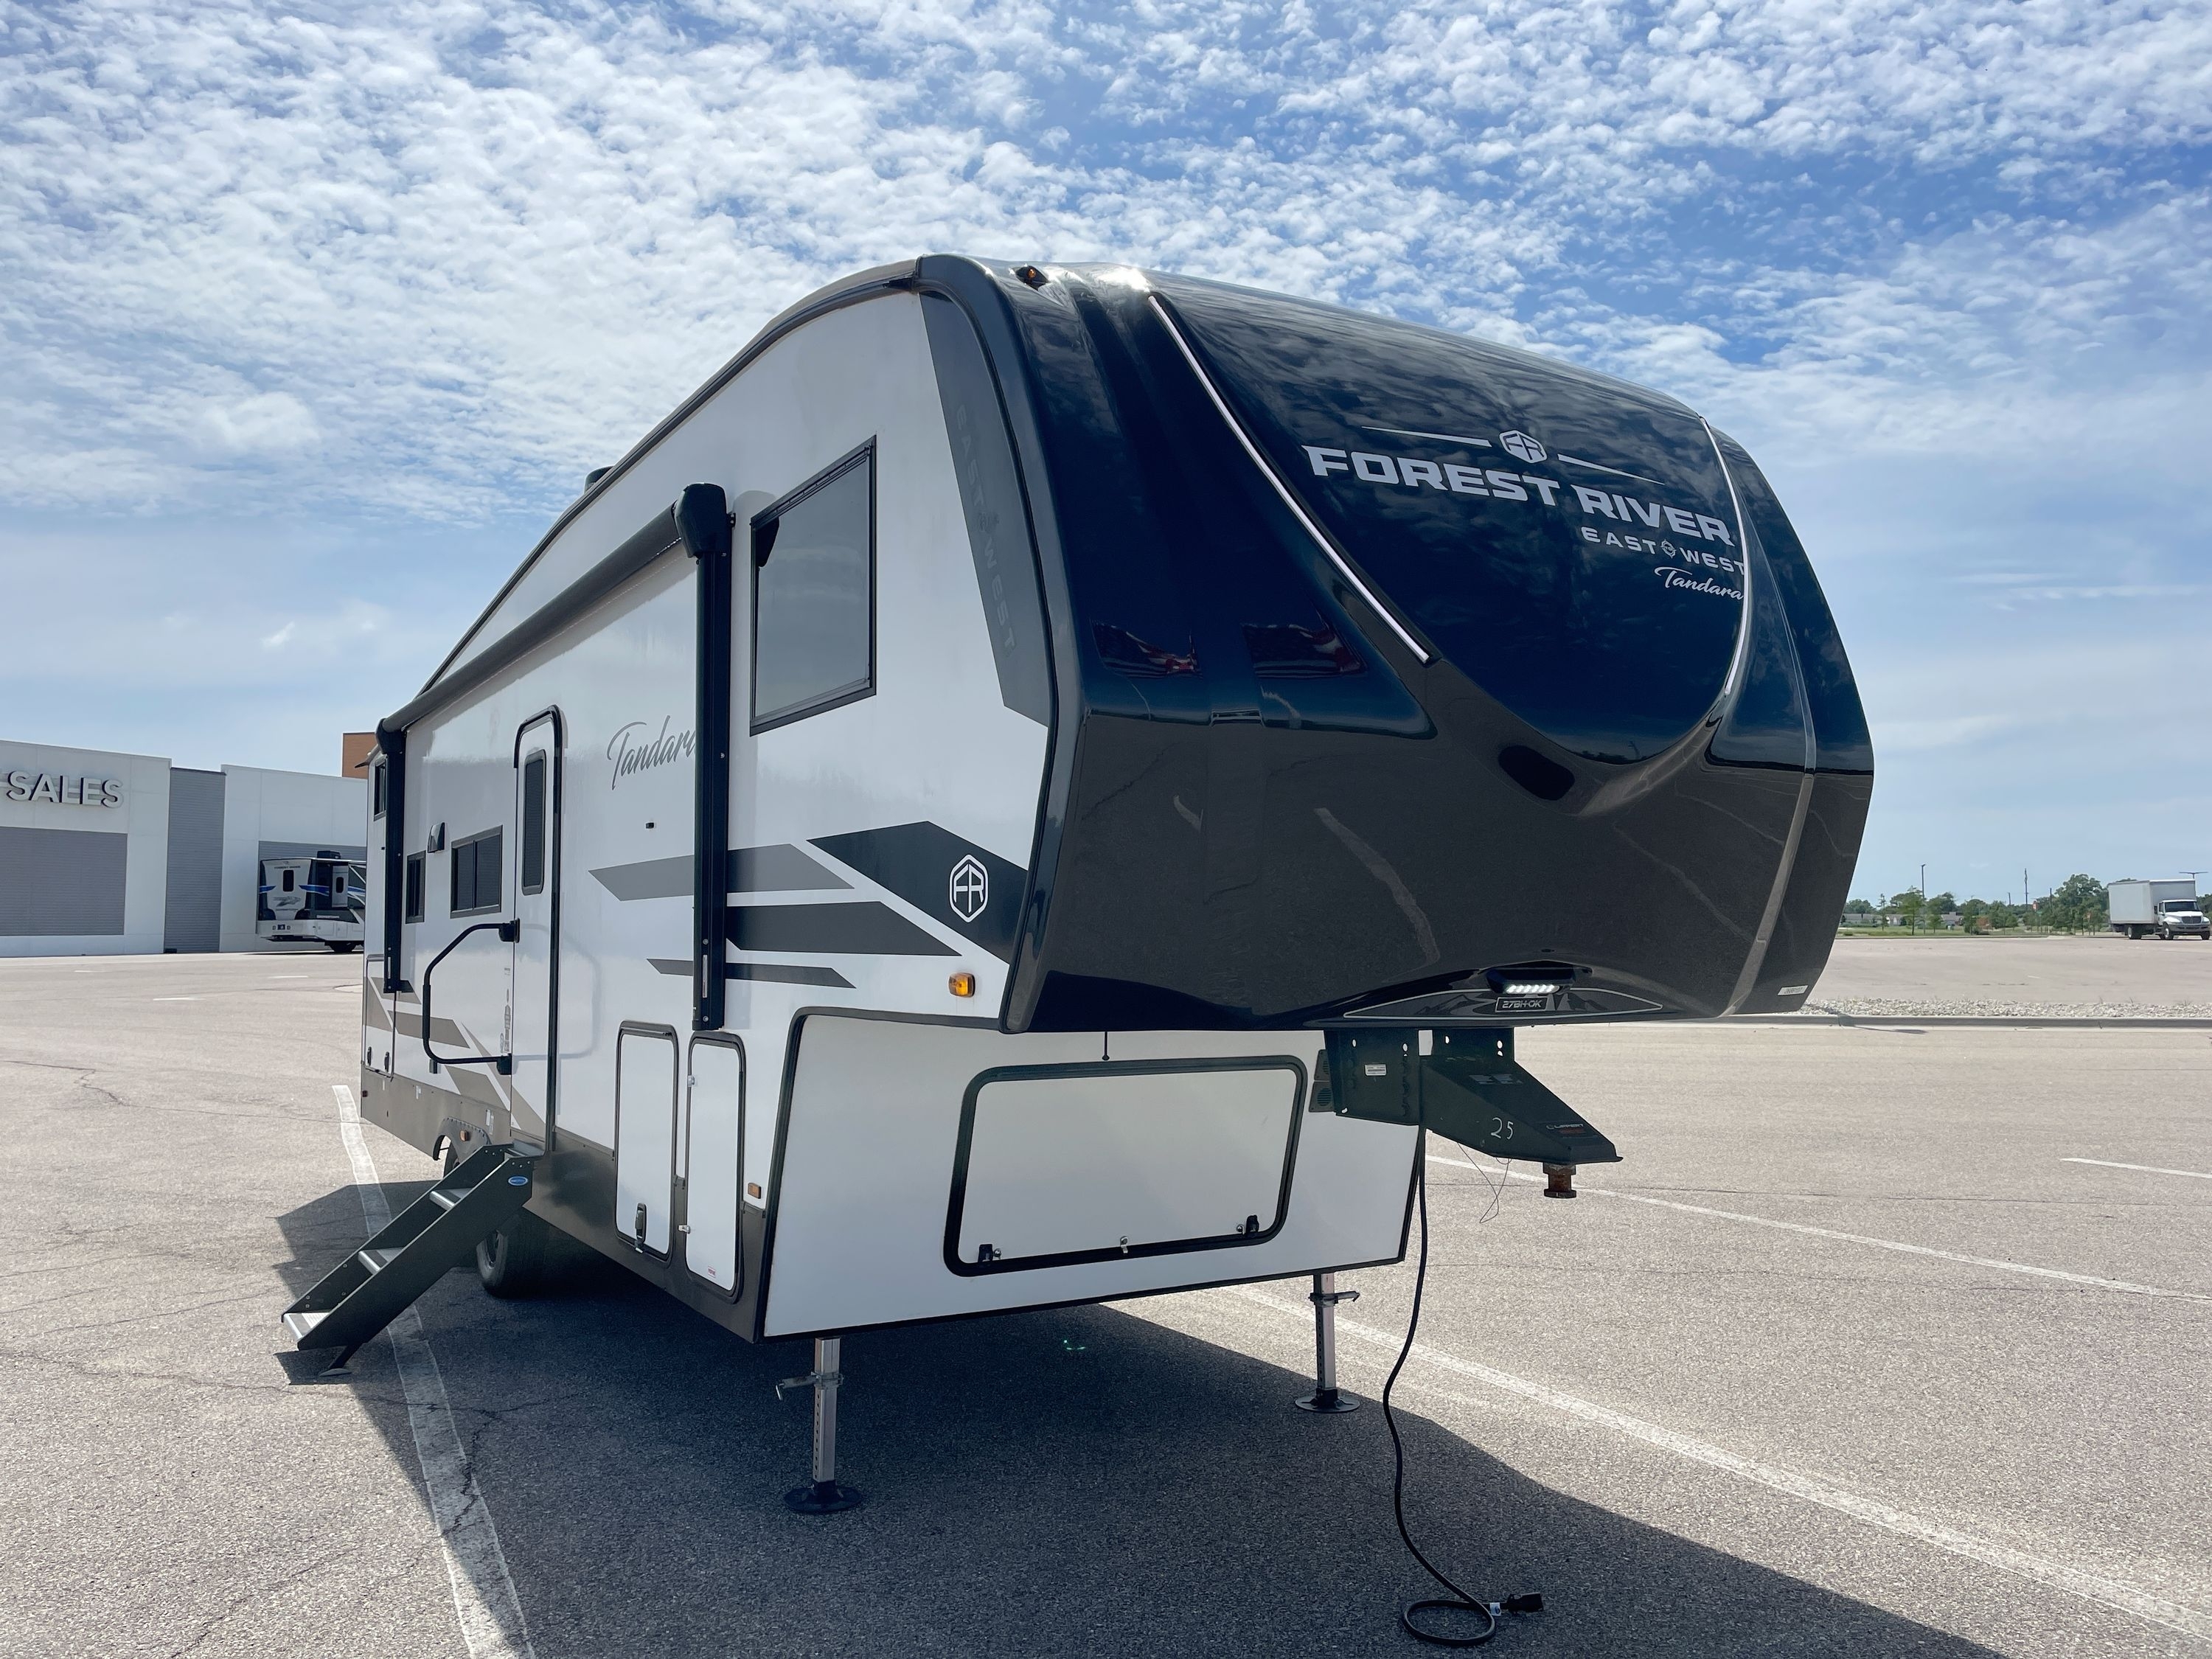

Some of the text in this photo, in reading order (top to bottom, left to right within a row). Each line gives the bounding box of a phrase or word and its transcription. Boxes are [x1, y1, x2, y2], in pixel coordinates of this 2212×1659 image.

[1301, 445, 1735, 547] FOREST RIVER
[956, 404, 1016, 650] EAST WEST
[1581, 526, 1657, 554] EAST
[1680, 547, 1745, 576] WEST
[1654, 566, 1744, 601] Tandara
[7, 771, 124, 809] SALES
[1490, 1117, 1514, 1139] 25
